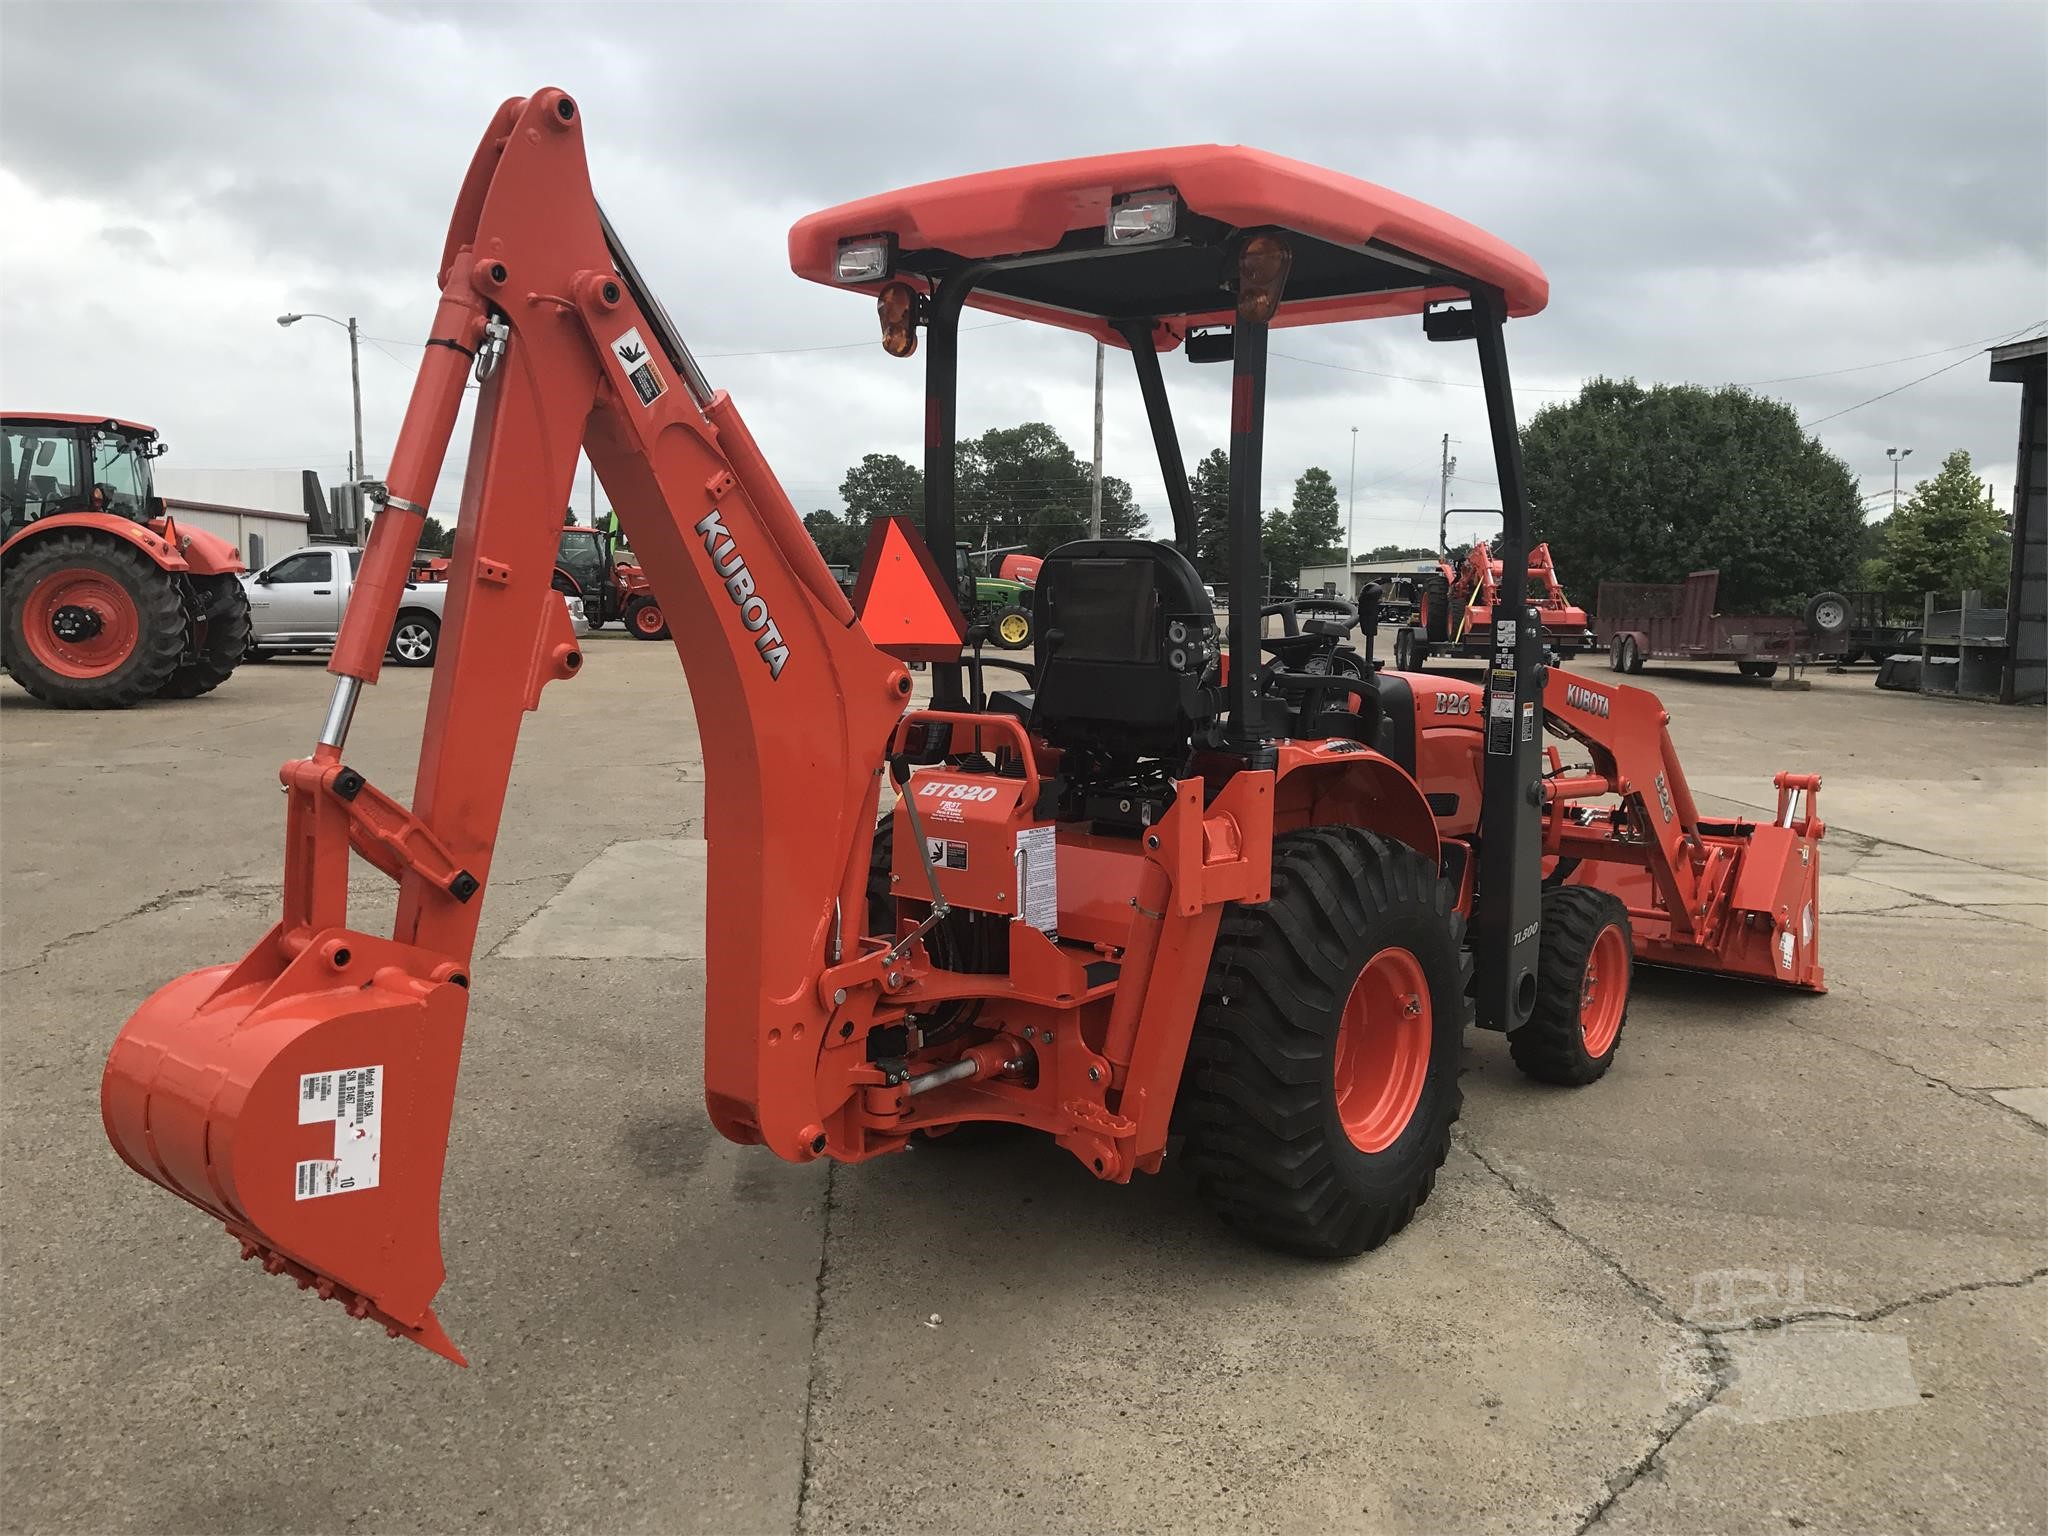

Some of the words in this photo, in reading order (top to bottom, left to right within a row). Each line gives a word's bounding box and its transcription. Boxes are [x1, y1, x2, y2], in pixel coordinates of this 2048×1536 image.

[694, 508, 790, 682] KUBOTA
[1434, 692, 1470, 716] B26
[1566, 683, 1609, 719] KUBOTA
[919, 782, 998, 802] BT820
[1513, 921, 1539, 946] TL500
[347, 1070, 357, 1082] S/N
[365, 1068, 375, 1087] Model
[340, 1176, 355, 1188] 10
